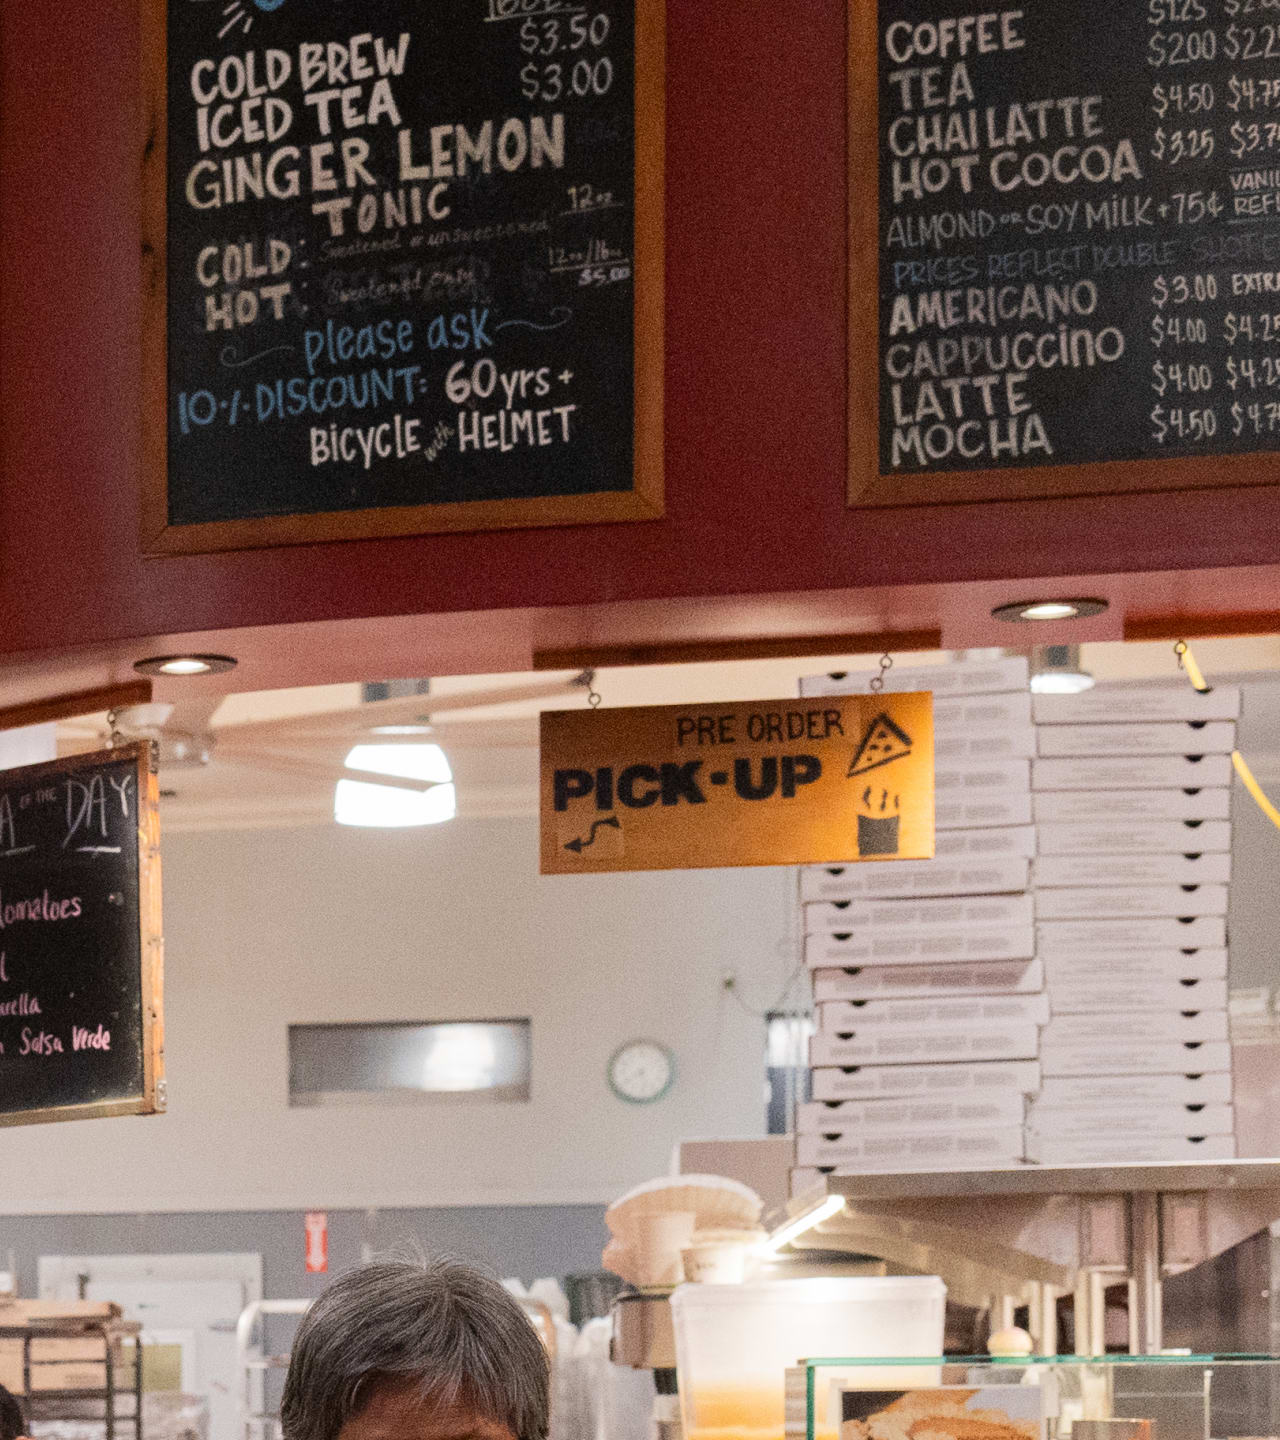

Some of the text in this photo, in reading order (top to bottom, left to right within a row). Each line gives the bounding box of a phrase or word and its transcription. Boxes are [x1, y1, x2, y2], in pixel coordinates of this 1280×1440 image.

[190, 13, 610, 105] COLD BREW $3.50
[885, 10, 1026, 63] COFFEE
[197, 56, 613, 152] ICED TEA $3.00
[888, 61, 974, 111] TEA
[888, 83, 1214, 157] CHAI LATTE $4.50
[186, 113, 566, 211] GINGER LEMON
[893, 120, 1280, 203] HOT COCOA $3.25 $3.7
[312, 182, 452, 237] TONIC
[886, 207, 995, 249] ALMOND
[1025, 195, 1078, 235] SOY
[889, 274, 1217, 336] AMERICANO $3.00
[1151, 314, 1207, 347] $4.00
[303, 308, 494, 372] please ask
[255, 364, 430, 422] DISCOUNT:
[892, 359, 1212, 425] LATTE $4.00
[458, 403, 576, 454] HELMET
[892, 404, 1216, 466] MOCHA $4.50
[676, 709, 844, 746] PRE ORDER
[61, 773, 137, 848] DAY
[19, 1027, 64, 1055] Salsa
[71, 1023, 111, 1051] Verde
